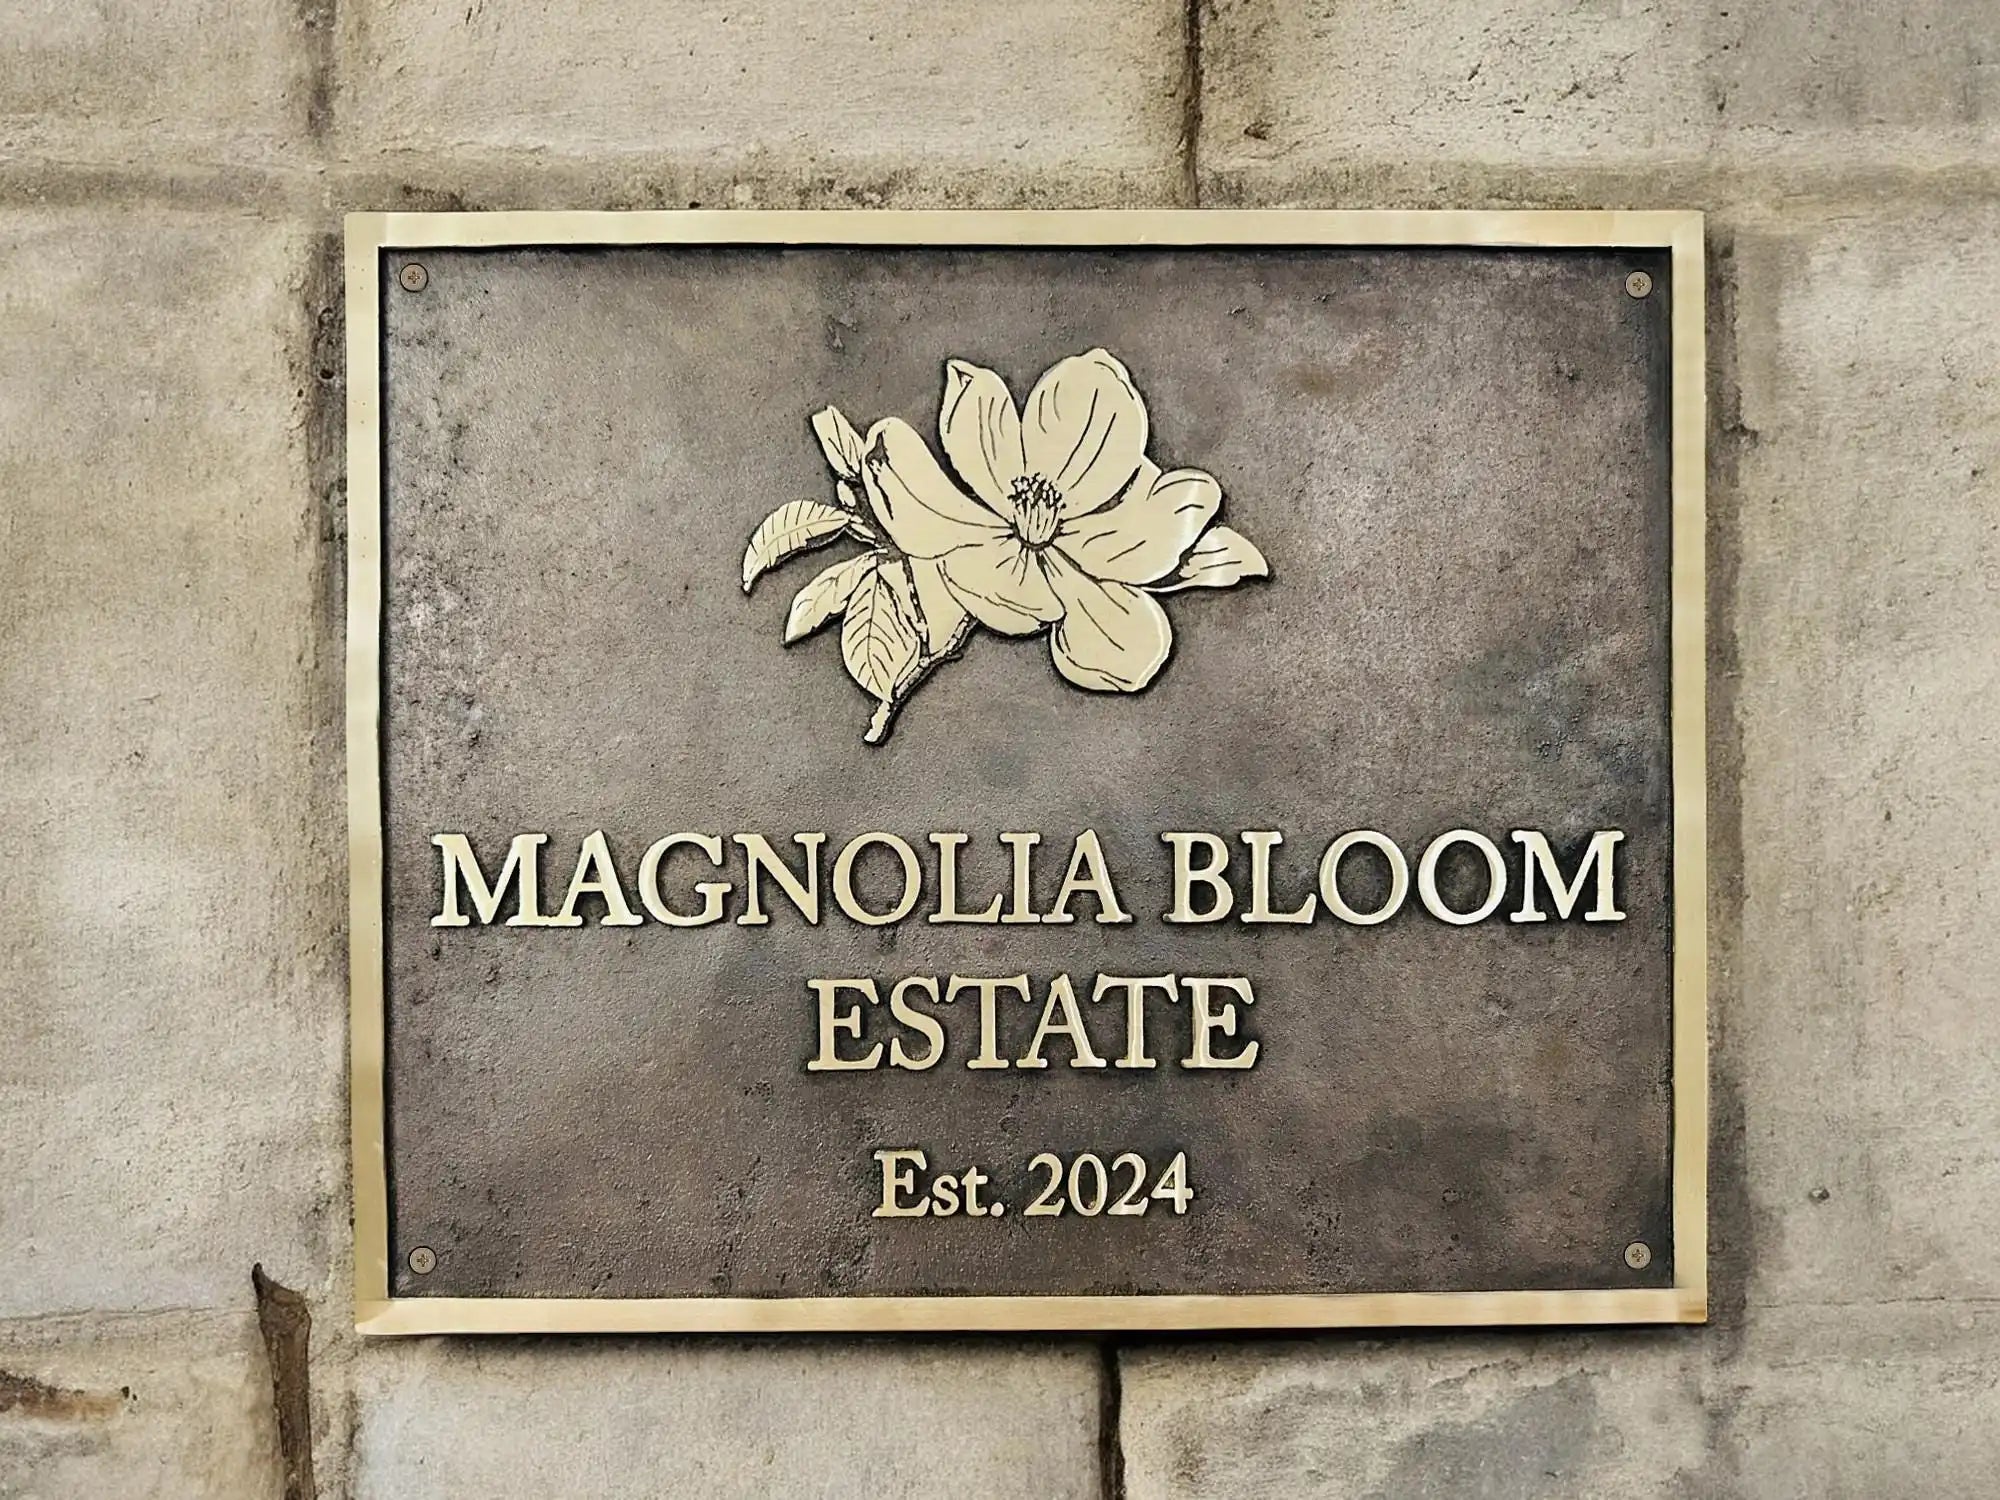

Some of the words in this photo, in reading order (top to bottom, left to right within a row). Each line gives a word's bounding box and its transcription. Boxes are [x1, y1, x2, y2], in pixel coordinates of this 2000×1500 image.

[431, 830, 1131, 926] MAGNOLIA
[1165, 829, 1626, 925] BLOOM
[808, 974, 1258, 1071] ESTATE
[873, 1151, 1005, 1218] Est.
[1024, 1152, 1194, 1217] 2024
